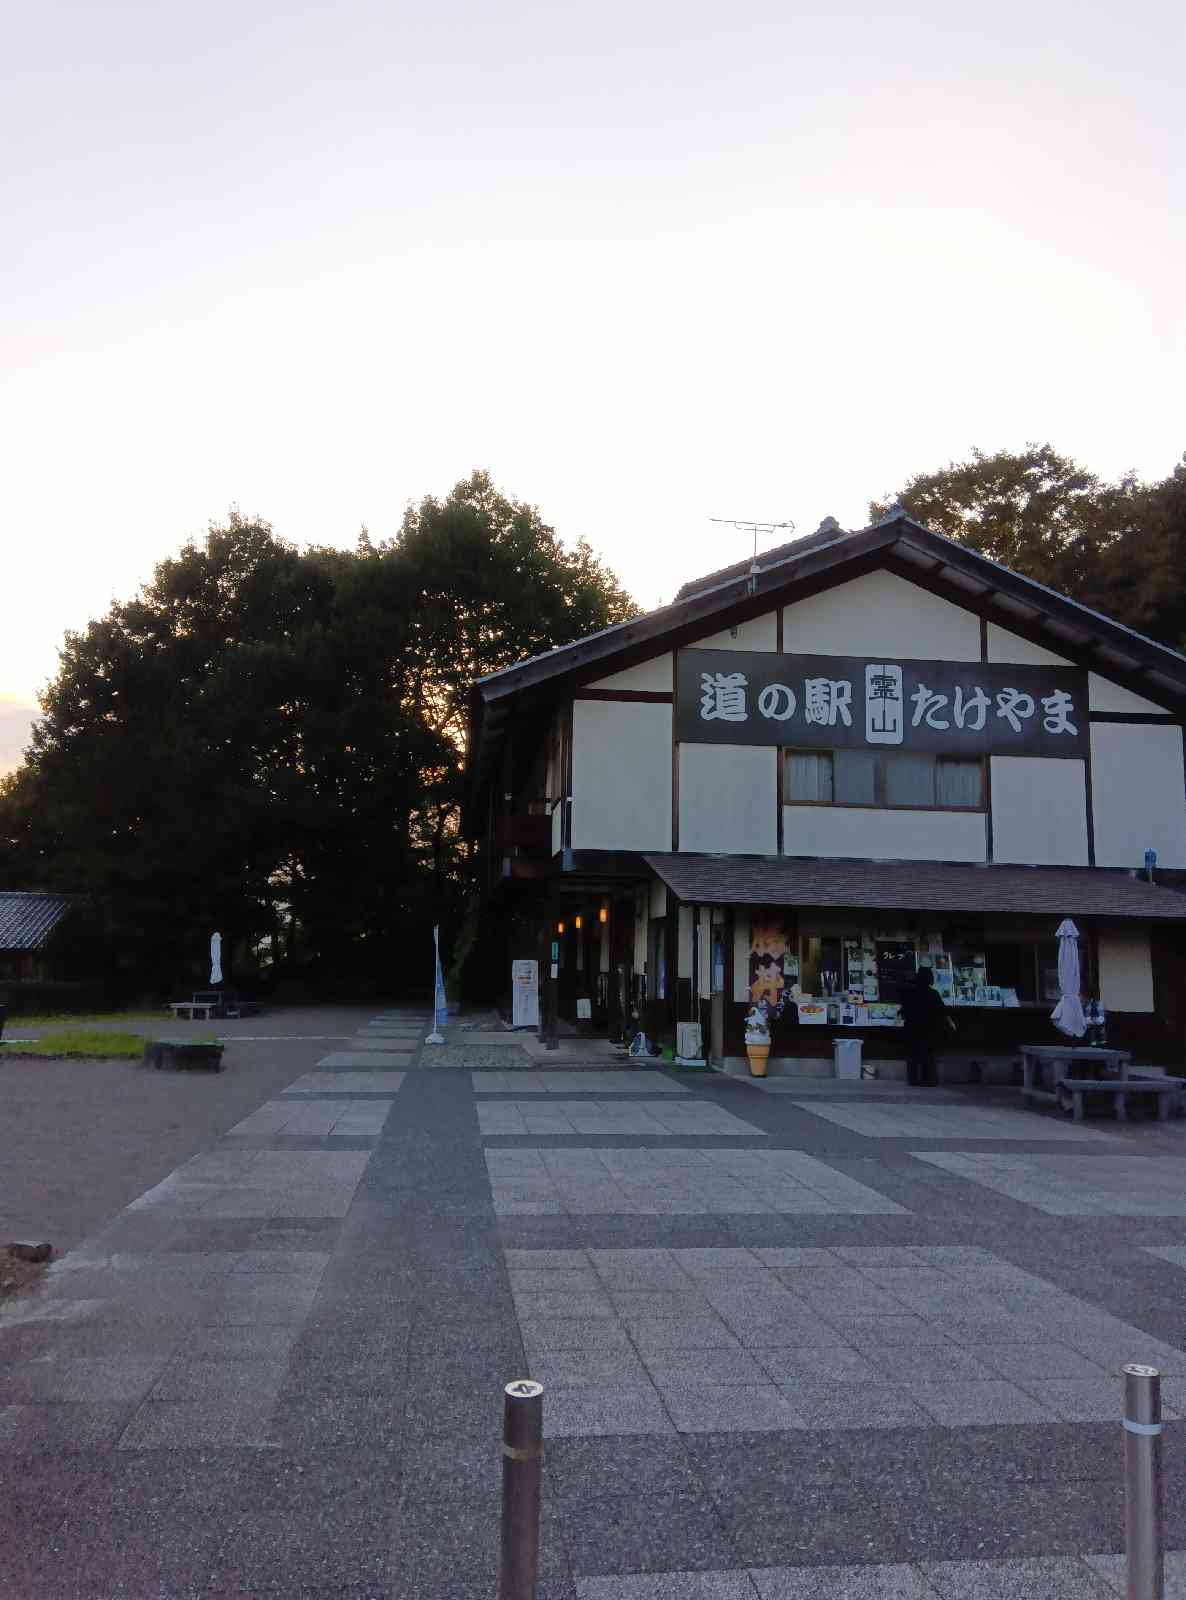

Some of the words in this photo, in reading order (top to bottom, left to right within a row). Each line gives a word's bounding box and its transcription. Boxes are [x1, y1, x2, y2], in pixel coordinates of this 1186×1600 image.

[699, 672, 854, 727] 道の駅
[909, 683, 1080, 737] たけやま
